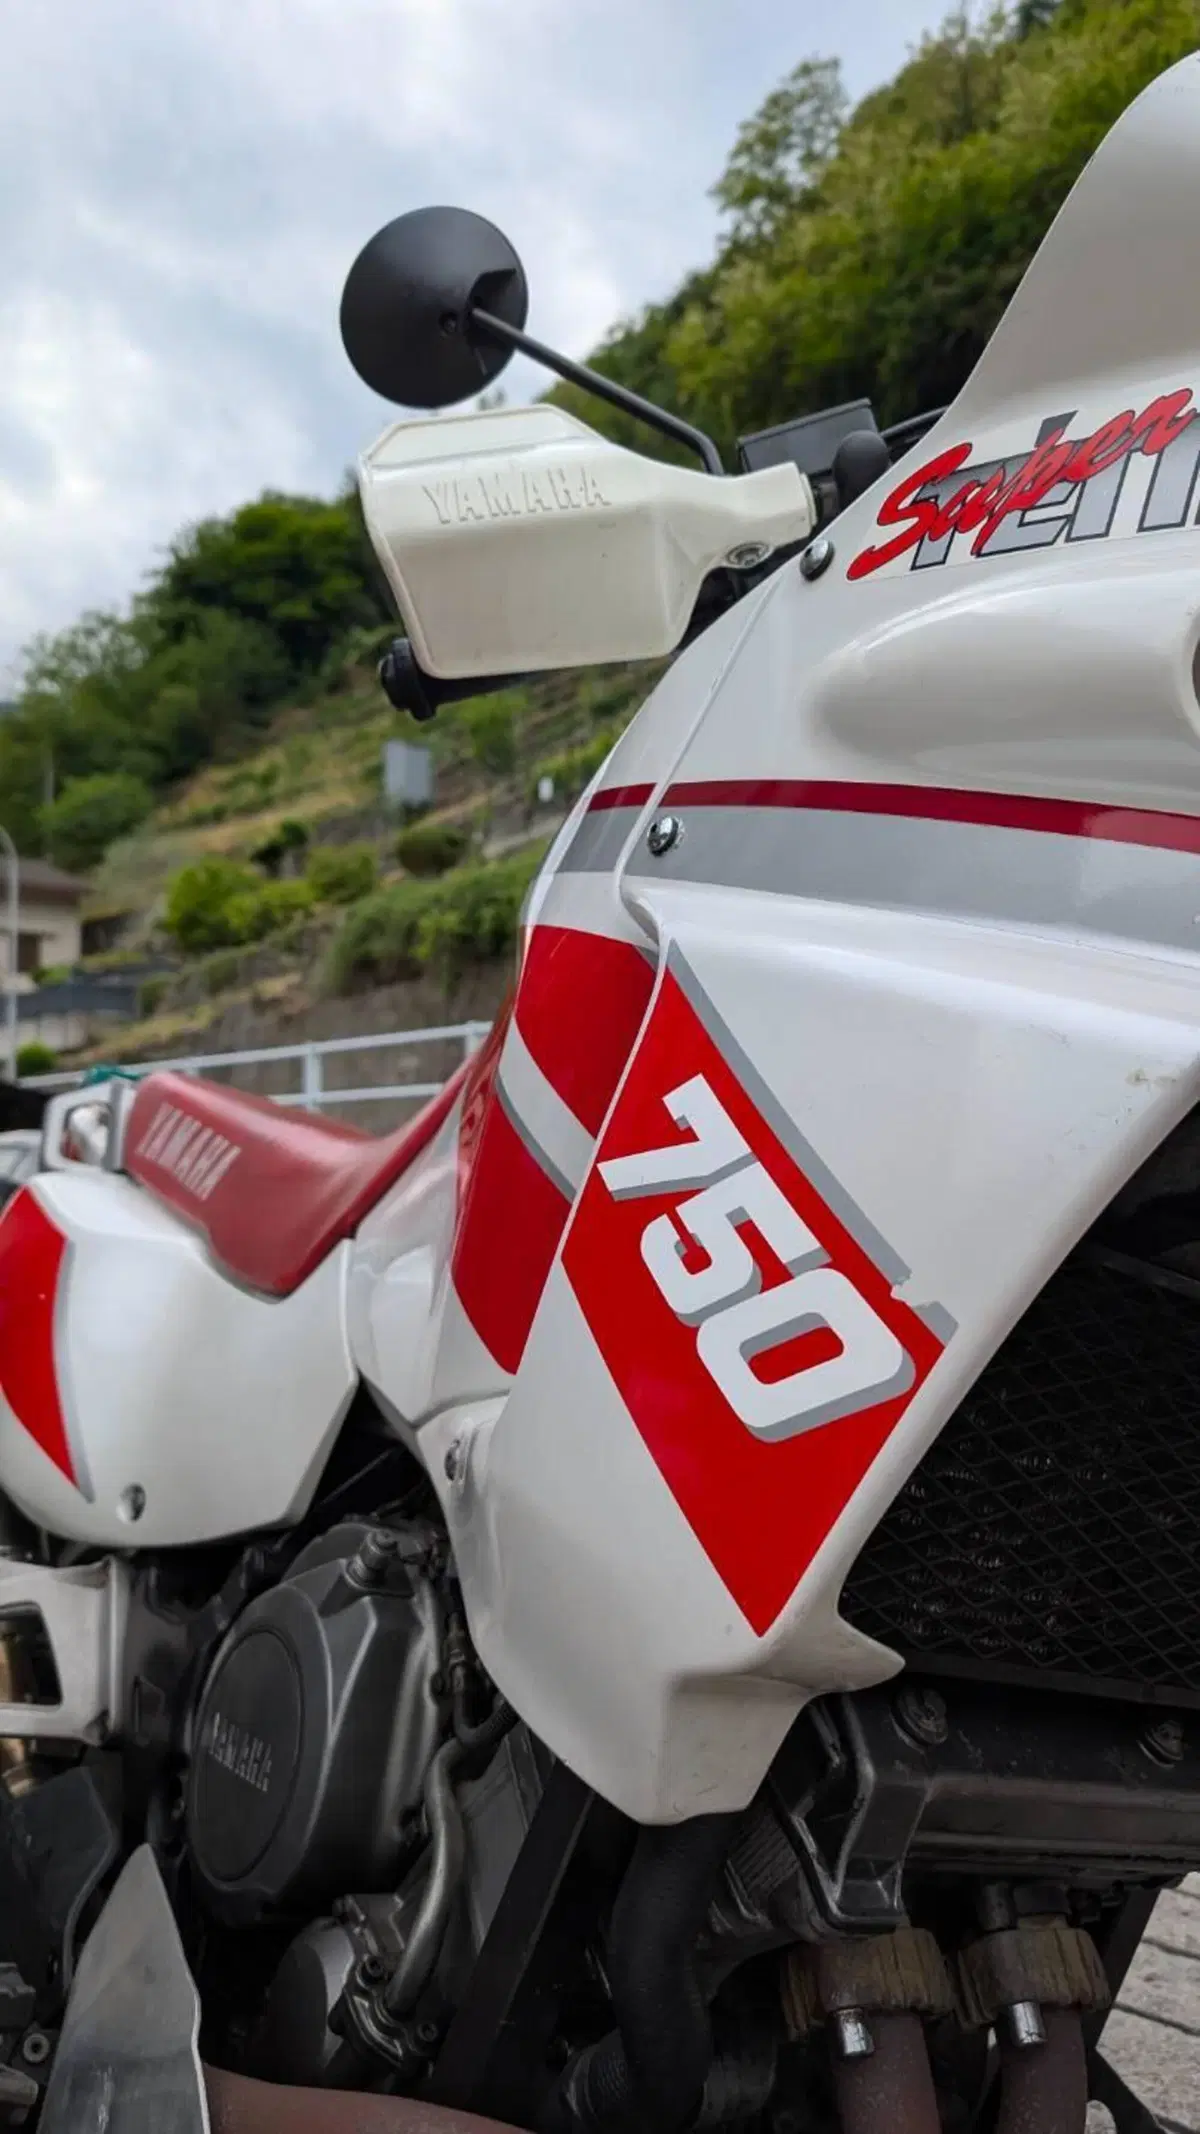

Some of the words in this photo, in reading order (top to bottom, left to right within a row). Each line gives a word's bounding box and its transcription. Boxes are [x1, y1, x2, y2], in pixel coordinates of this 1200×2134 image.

[422, 466, 612, 524] YAMAHA
[846, 388, 1198, 581] Super
[134, 1102, 242, 1201] YAMAHA
[597, 1073, 917, 1443] 750
